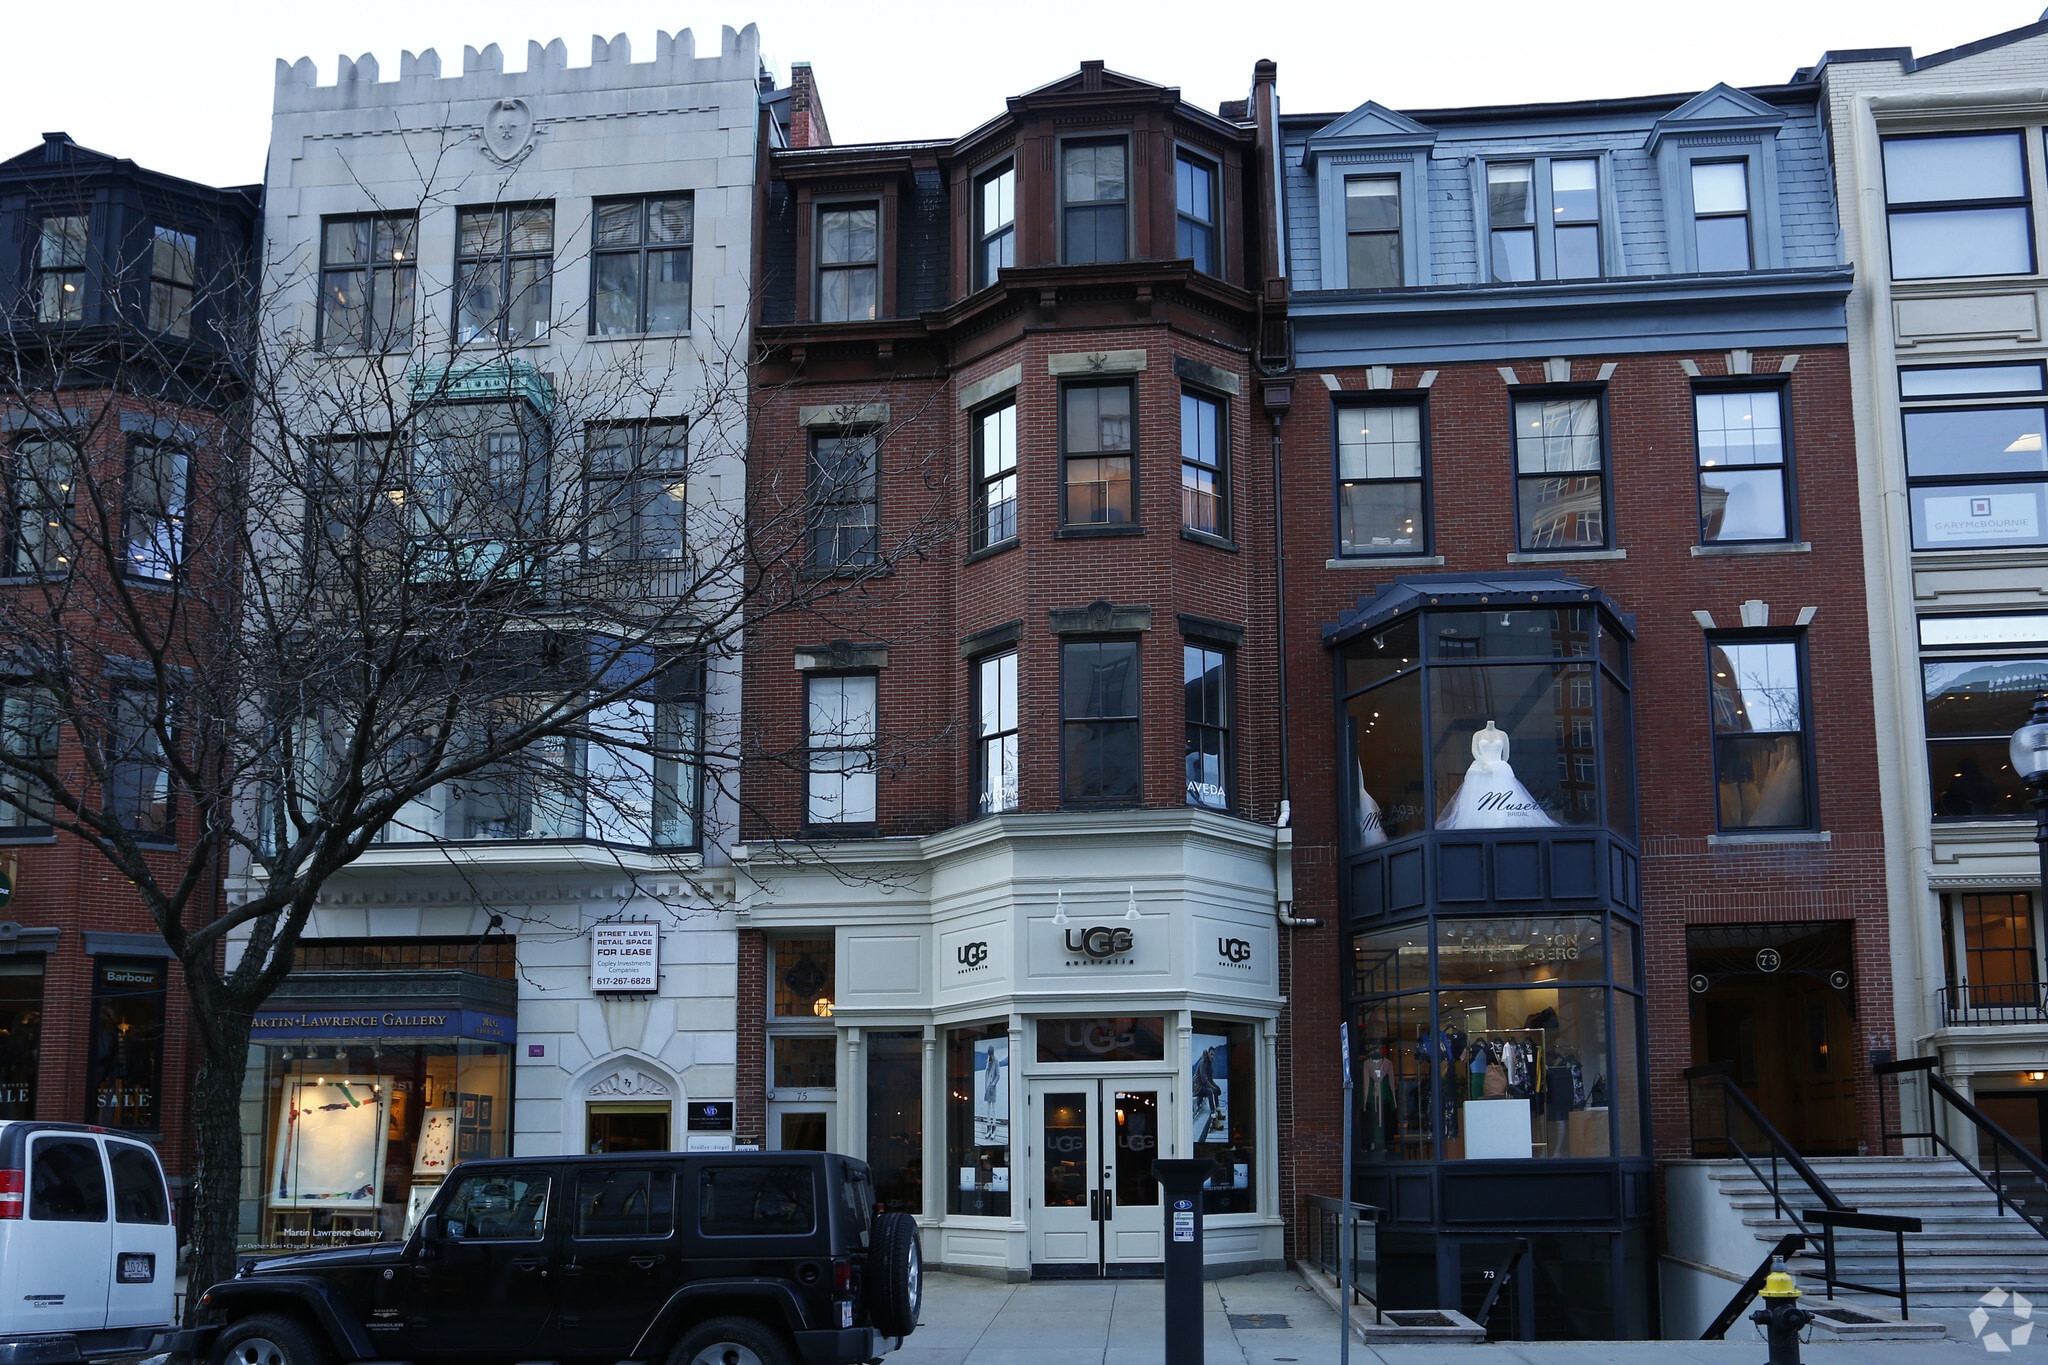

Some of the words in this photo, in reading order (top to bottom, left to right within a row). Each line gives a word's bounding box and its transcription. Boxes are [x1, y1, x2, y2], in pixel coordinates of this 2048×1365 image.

[1187, 781, 1226, 796] AVEDA
[979, 786, 1018, 806] AVDA
[1064, 926, 1134, 958] UGG
[1544, 934, 1578, 946] VON
[958, 942, 988, 967] UGG
[1218, 938, 1250, 963] UGG
[1066, 958, 1134, 966] australia
[1759, 954, 1778, 966] 73
[107, 971, 154, 983] Barbour
[250, 1017, 294, 1028] ARTIN
[302, 1014, 378, 1027] LAWRENCE
[382, 1013, 446, 1026] GALLERY
[1064, 1020, 1136, 1054] UGG
[624, 1078, 632, 1088] 77
[97, 1094, 150, 1108] SALE
[797, 1092, 808, 1100] 75
[703, 1106, 718, 1115] WD
[1047, 1136, 1083, 1152] UGG
[1119, 1135, 1155, 1151] UGG
[284, 1228, 310, 1236] Martin
[354, 1228, 383, 1238] Gallery
